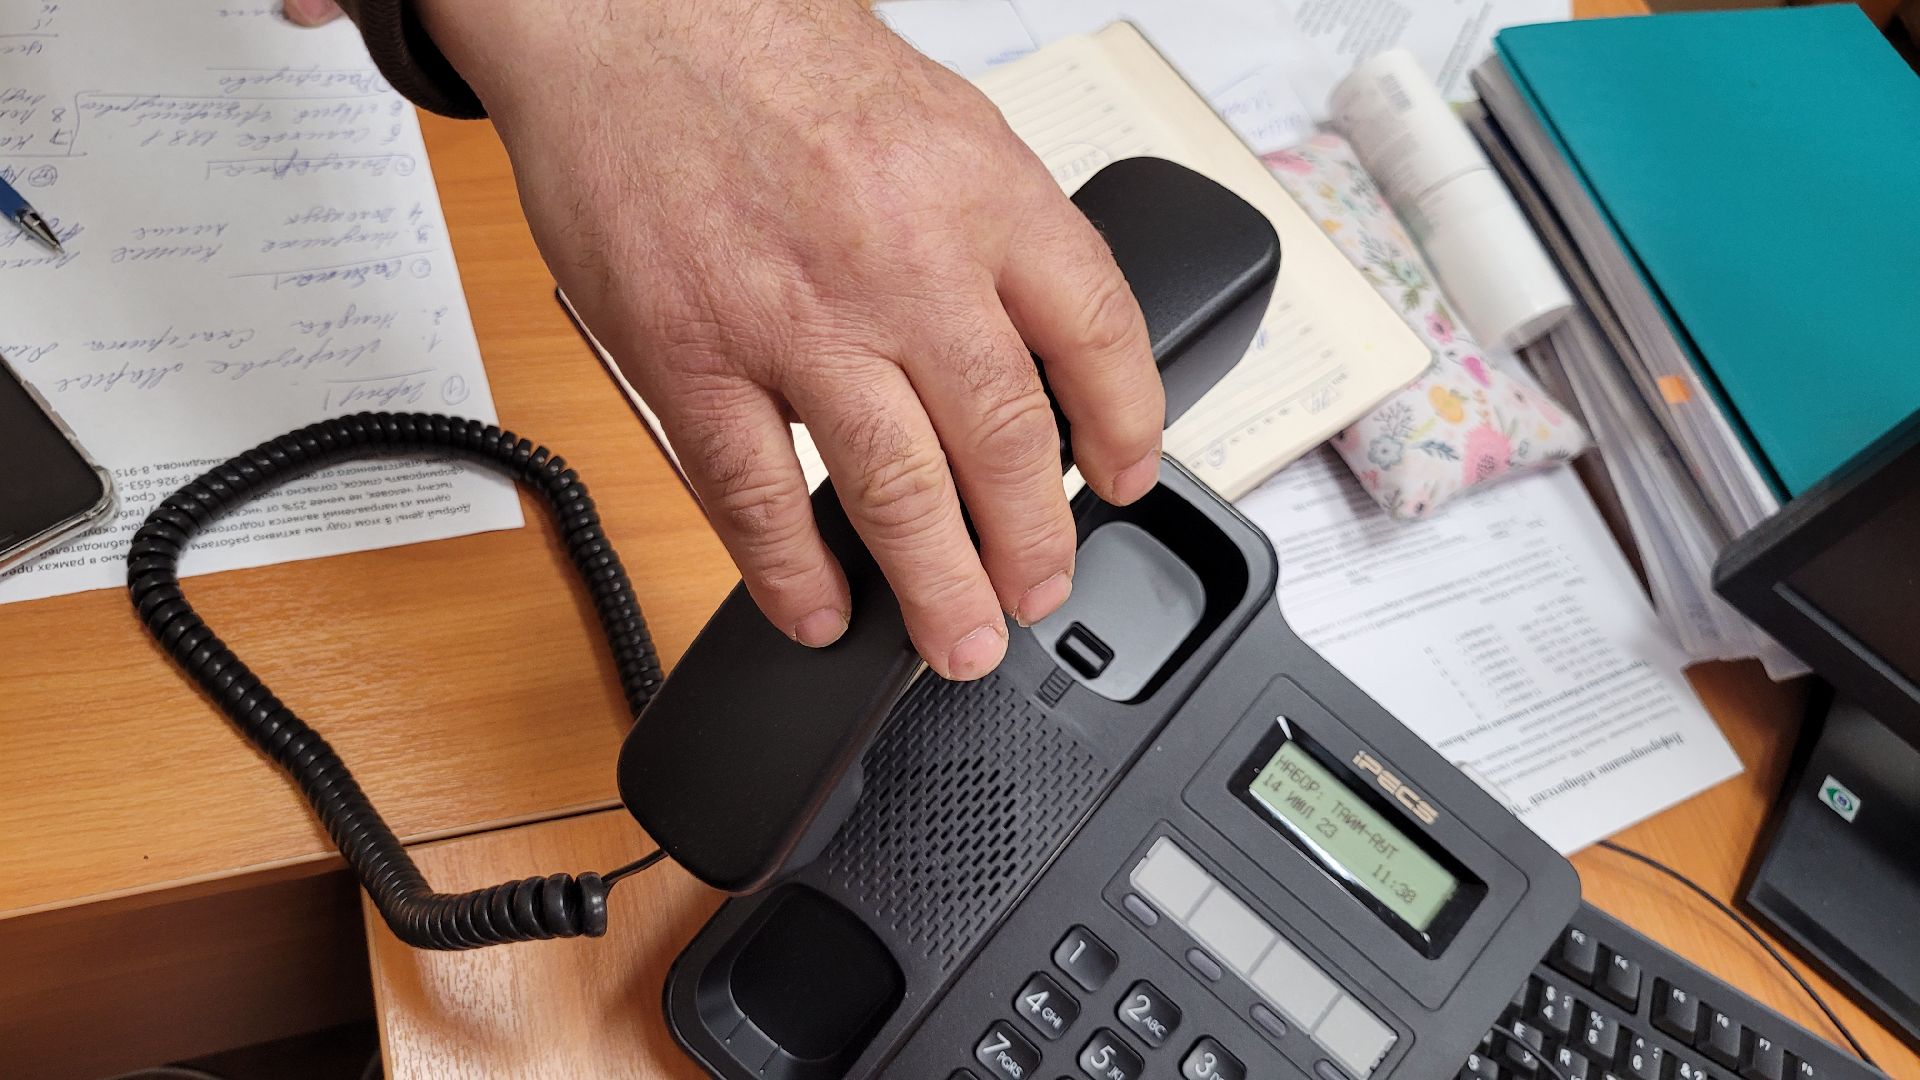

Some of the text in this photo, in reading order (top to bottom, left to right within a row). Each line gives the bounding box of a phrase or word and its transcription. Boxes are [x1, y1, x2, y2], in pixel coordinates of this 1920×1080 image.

[125, 491, 155, 502] Срок
[309, 496, 344, 505] менее
[399, 499, 411, 507] из
[416, 493, 451, 503] одним
[266, 504, 278, 512] от
[281, 500, 306, 512] 25%
[322, 501, 396, 518] направлений
[427, 503, 470, 516] Добрый
[268, 512, 318, 525] является
[395, 509, 424, 520] день!
[326, 520, 350, 531] году
[354, 518, 380, 526] этом
[190, 534, 249, 549] работаем
[252, 528, 300, 541] активно
[38, 556, 84, 571] рамках
[1273, 754, 1326, 801] НАБОР:
[1350, 748, 1440, 827] iPECS
[1262, 772, 1284, 793] 14
[1314, 816, 1339, 840] 23
[1369, 862, 1418, 906] 11:38
[1068, 940, 1086, 964] 1
[1025, 991, 1064, 1029] 4 GHI
[1127, 994, 1168, 1039] 2 ABC
[982, 1031, 1011, 1055] 7
[1090, 1045, 1116, 1070] 5
[1195, 1052, 1217, 1076] 3
